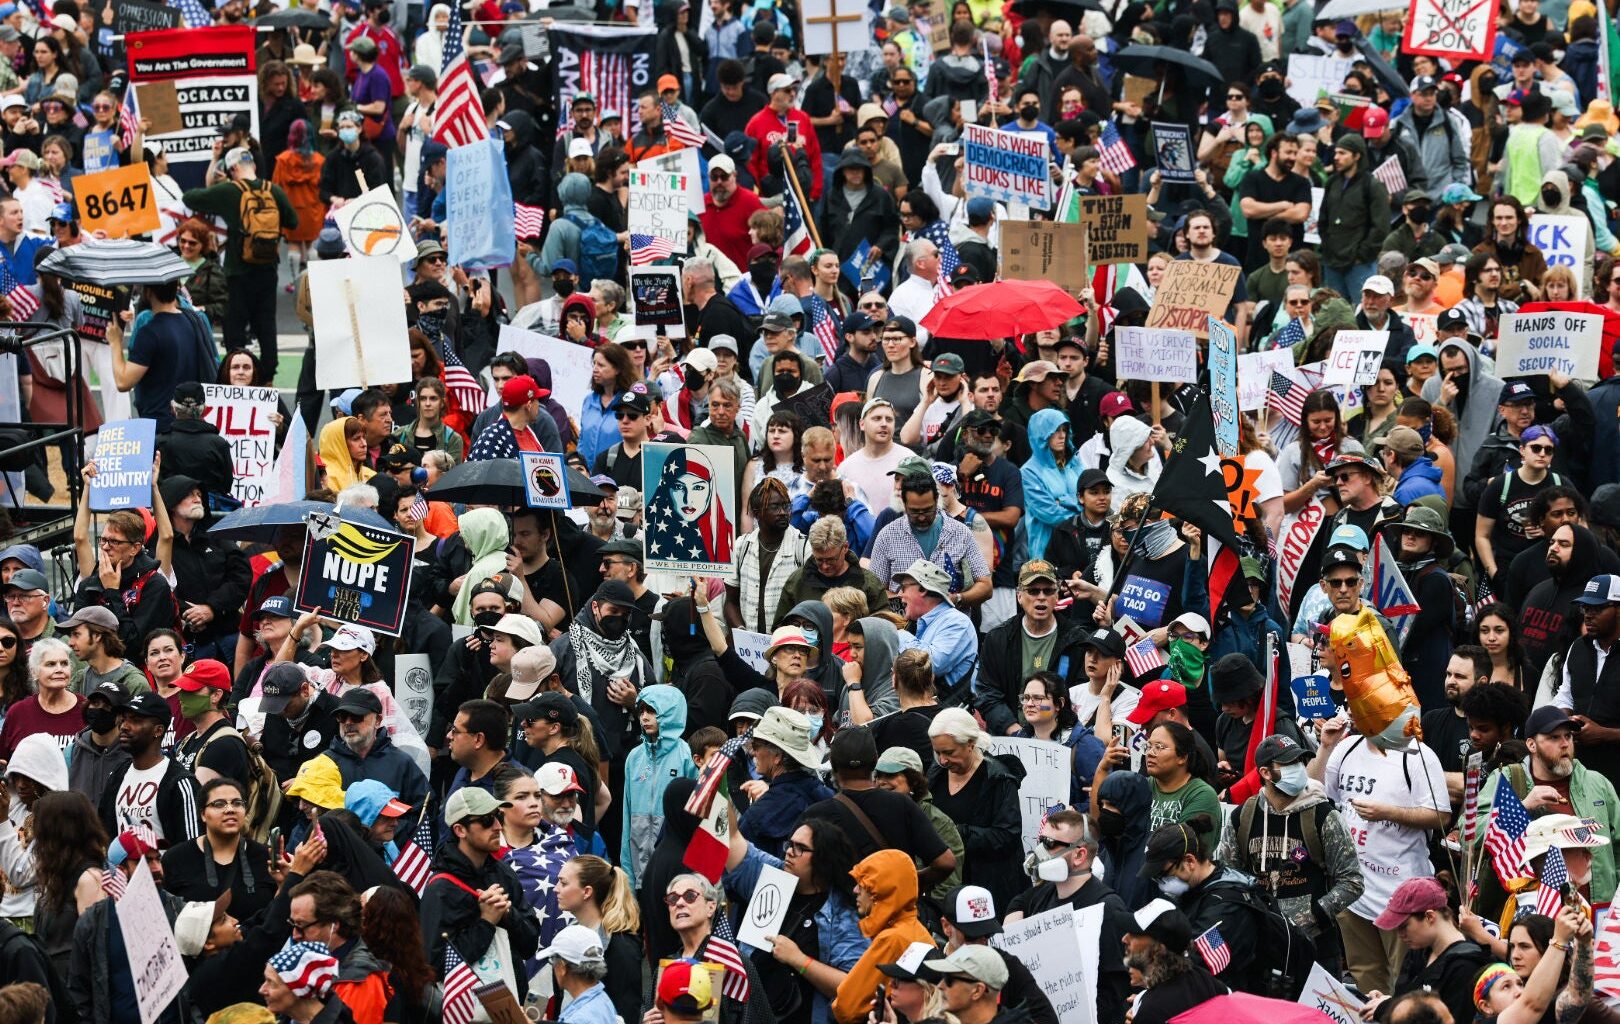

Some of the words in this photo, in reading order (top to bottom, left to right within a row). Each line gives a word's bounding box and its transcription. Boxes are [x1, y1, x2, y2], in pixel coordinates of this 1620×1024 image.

[1426, 14, 1476, 30] JONG
[1427, 32, 1472, 50] DON
[136, 63, 152, 72] You
[155, 61, 170, 72] Are
[172, 60, 188, 70] The
[190, 58, 246, 68] Government
[632, 53, 649, 86] NO
[177, 88, 246, 104] OCRACY
[968, 126, 994, 148] THIS
[997, 134, 1008, 151] IS
[1010, 136, 1044, 158] WHAT
[968, 144, 1044, 177] DEMOCRACY
[648, 173, 670, 192] MY
[968, 162, 1010, 189] LOOKS
[1014, 173, 1045, 196] LIKE
[84, 184, 148, 219] 8647
[630, 192, 688, 214] EXISTENCE
[1083, 196, 1123, 214] THIS
[652, 212, 664, 228] IS
[1167, 262, 1192, 277] THIS
[1192, 264, 1209, 274] IS
[1212, 264, 1240, 282] NOT
[1168, 276, 1226, 296] NORMAL
[1160, 291, 1187, 306] THIS
[1190, 294, 1208, 308] IS
[1514, 317, 1556, 332] HANDS
[1564, 318, 1586, 332] OFF
[1120, 332, 1144, 346] LET
[1146, 335, 1160, 348] US
[1162, 336, 1194, 349] DRIVE
[1528, 336, 1570, 350] SOCIAL
[1120, 346, 1144, 359] THE
[1151, 348, 1193, 366] MIGHTY
[1331, 351, 1356, 369] ICE
[1122, 361, 1145, 374] FROM
[1518, 357, 1574, 376] SECURITY
[206, 386, 278, 402] EPUBLICONS
[98, 426, 124, 444] FREE
[95, 440, 140, 457] SPEECH
[230, 440, 268, 460] MEN
[95, 456, 122, 472] FREE
[232, 459, 270, 477] LLY
[92, 470, 150, 489] COUNTRY
[1122, 584, 1144, 598] LET'S
[1144, 590, 1161, 602] GO
[333, 600, 360, 622] 1776
[1124, 596, 1146, 612] TACO
[739, 648, 750, 656] DO
[1304, 678, 1316, 688] WE
[1302, 697, 1328, 706] PEOPLE
[1307, 688, 1318, 697] the
[1028, 746, 1060, 769] THE
[1338, 774, 1376, 795] LESS
[118, 782, 158, 806] NO
[1360, 860, 1400, 876] rance
[1024, 922, 1042, 941] should
[1044, 920, 1052, 932] be
[1044, 980, 1058, 994] the
